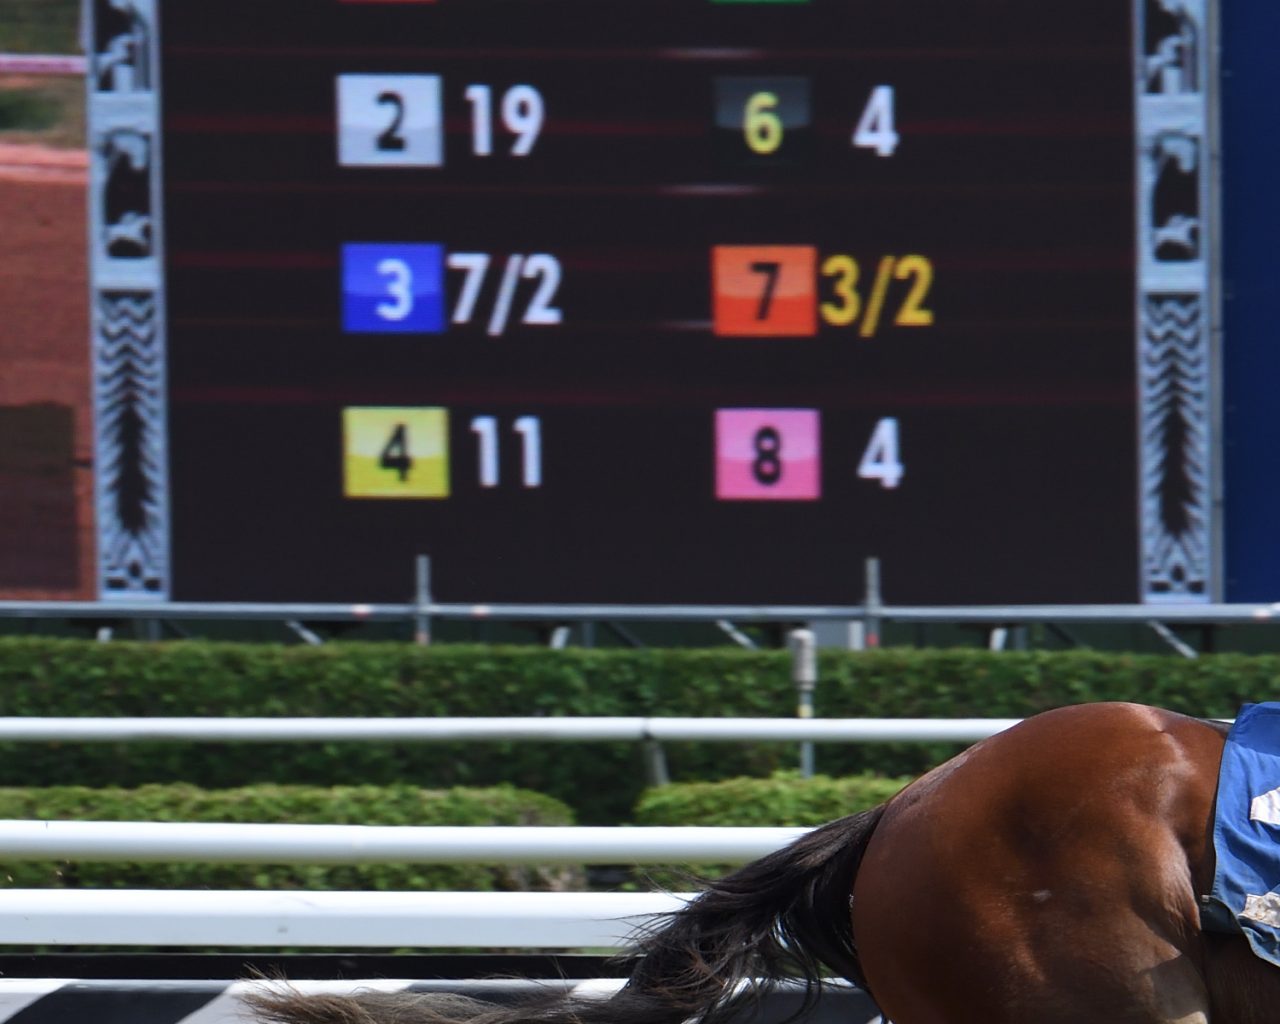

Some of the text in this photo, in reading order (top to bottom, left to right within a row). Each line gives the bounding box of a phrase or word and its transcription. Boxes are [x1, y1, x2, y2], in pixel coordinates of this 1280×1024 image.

[375, 83, 544, 157] 2 19
[744, 84, 899, 158] 6 4
[378, 252, 561, 336] 3 7/2
[749, 254, 932, 336] 7 3/2
[377, 415, 542, 488] 4 11
[750, 417, 904, 489] 8 4
